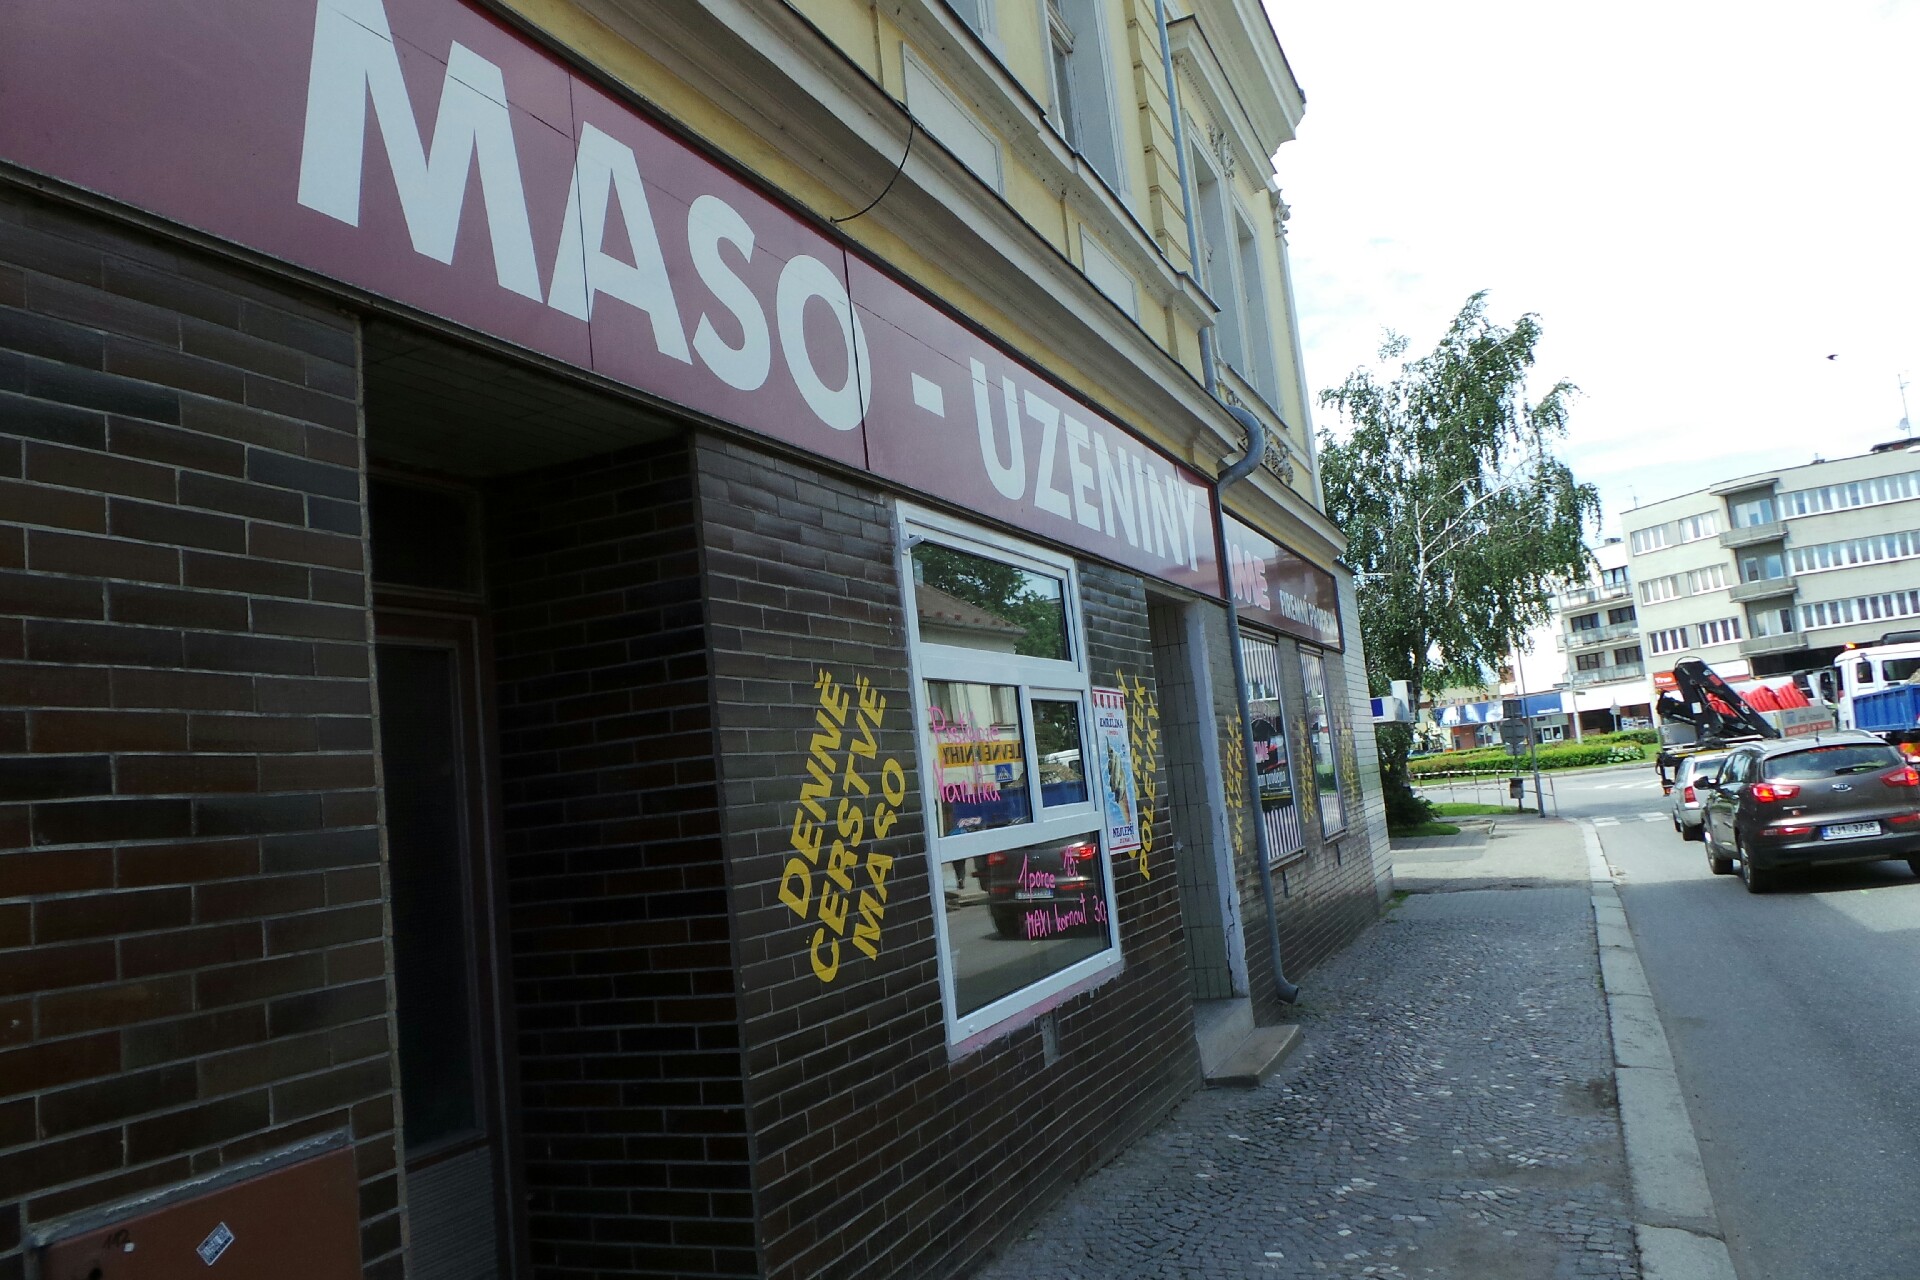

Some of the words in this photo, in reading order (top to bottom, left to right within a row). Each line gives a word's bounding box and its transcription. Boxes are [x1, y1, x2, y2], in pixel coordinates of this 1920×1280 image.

[298, 0, 871, 431] MASO
[969, 357, 1199, 572] UZENINY
[777, 668, 852, 919] DENNĚ
[932, 759, 1001, 805] Vanilka
[851, 757, 906, 961] MASO
[1018, 853, 1028, 892] 1
[1029, 870, 1056, 903] porce
[1026, 907, 1051, 940] MAXI
[1054, 893, 1087, 933] kornout
